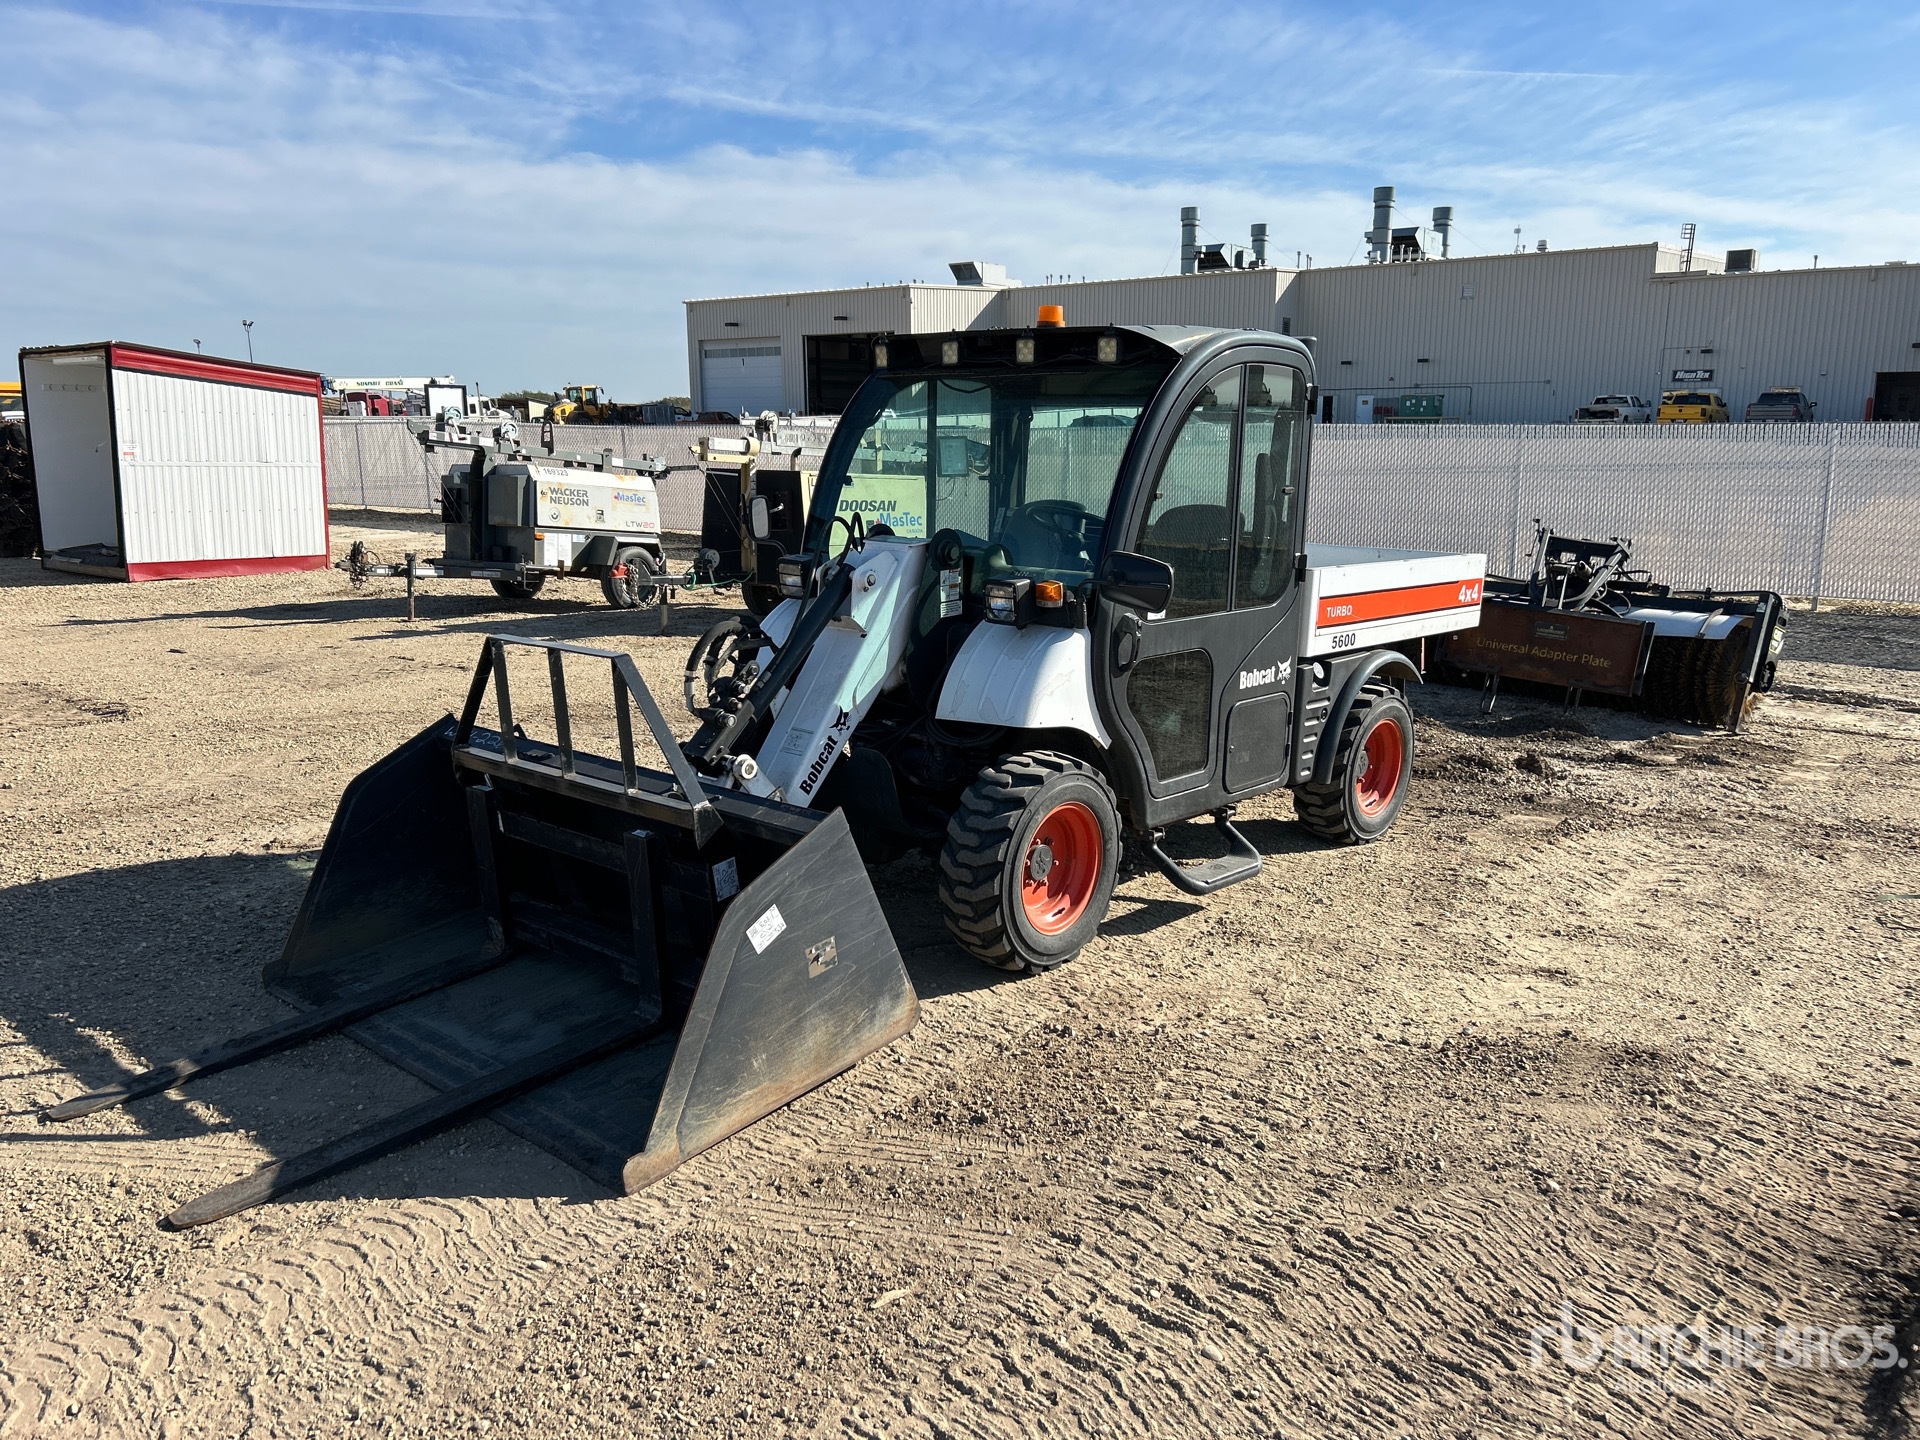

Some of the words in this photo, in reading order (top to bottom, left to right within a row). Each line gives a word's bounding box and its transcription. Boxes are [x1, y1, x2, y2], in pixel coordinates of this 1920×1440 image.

[549, 486, 589, 498] WACKER
[617, 492, 646, 503] MasTec
[549, 496, 590, 507] NEUSON
[839, 500, 897, 512] DOOSAN
[625, 520, 655, 529] LTW20
[879, 512, 922, 527] MasTec
[1458, 582, 1479, 603] 4x4
[1326, 605, 1352, 618] TURBO
[1331, 632, 1356, 649] 5600
[1476, 637, 1529, 654] Universal
[1530, 645, 1579, 662] Adapter
[1581, 653, 1612, 668] Plate
[1239, 665, 1276, 690] Bobcat
[799, 735, 838, 795] Bobcat
